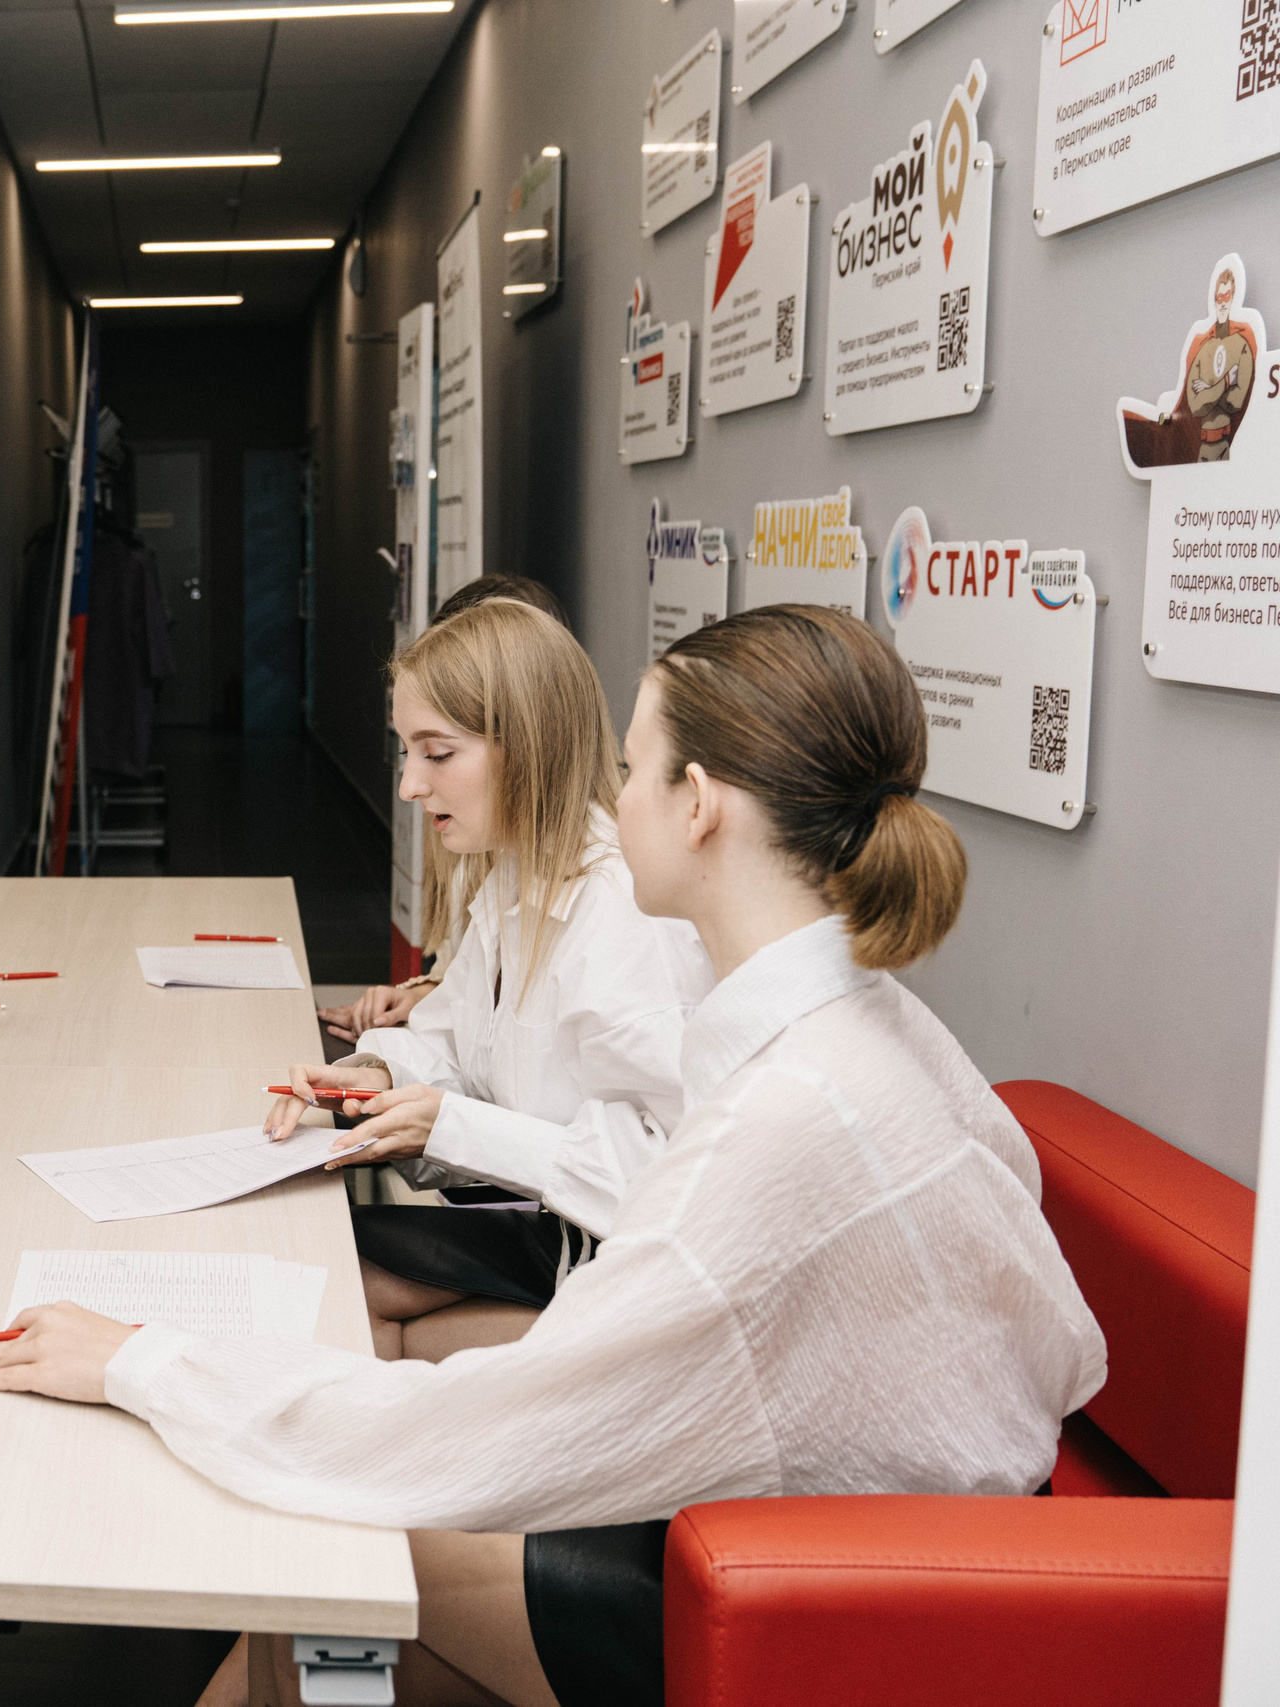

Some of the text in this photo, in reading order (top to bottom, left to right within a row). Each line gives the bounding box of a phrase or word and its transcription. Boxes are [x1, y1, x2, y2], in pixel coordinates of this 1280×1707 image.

[1056, 54, 1176, 124] Координация и развитие
[1055, 94, 1157, 154] предпринимательства
[873, 133, 926, 218] мой
[1053, 135, 1131, 181] в Пермском крае
[837, 203, 923, 278] бизнес
[754, 506, 819, 568] НАЧНИ
[1174, 506, 1215, 532] «Этому
[1216, 509, 1259, 531] городу
[927, 549, 1021, 598] СТАРТ
[1172, 538, 1222, 562] Superbot
[1225, 542, 1258, 559] готов
[1031, 573, 1078, 588] ИННОВАЦИЯМ
[1170, 573, 1236, 595] поддержка,
[1168, 599, 1188, 621] Всё
[1189, 605, 1211, 625] для
[1214, 601, 1263, 626] бизнеса
